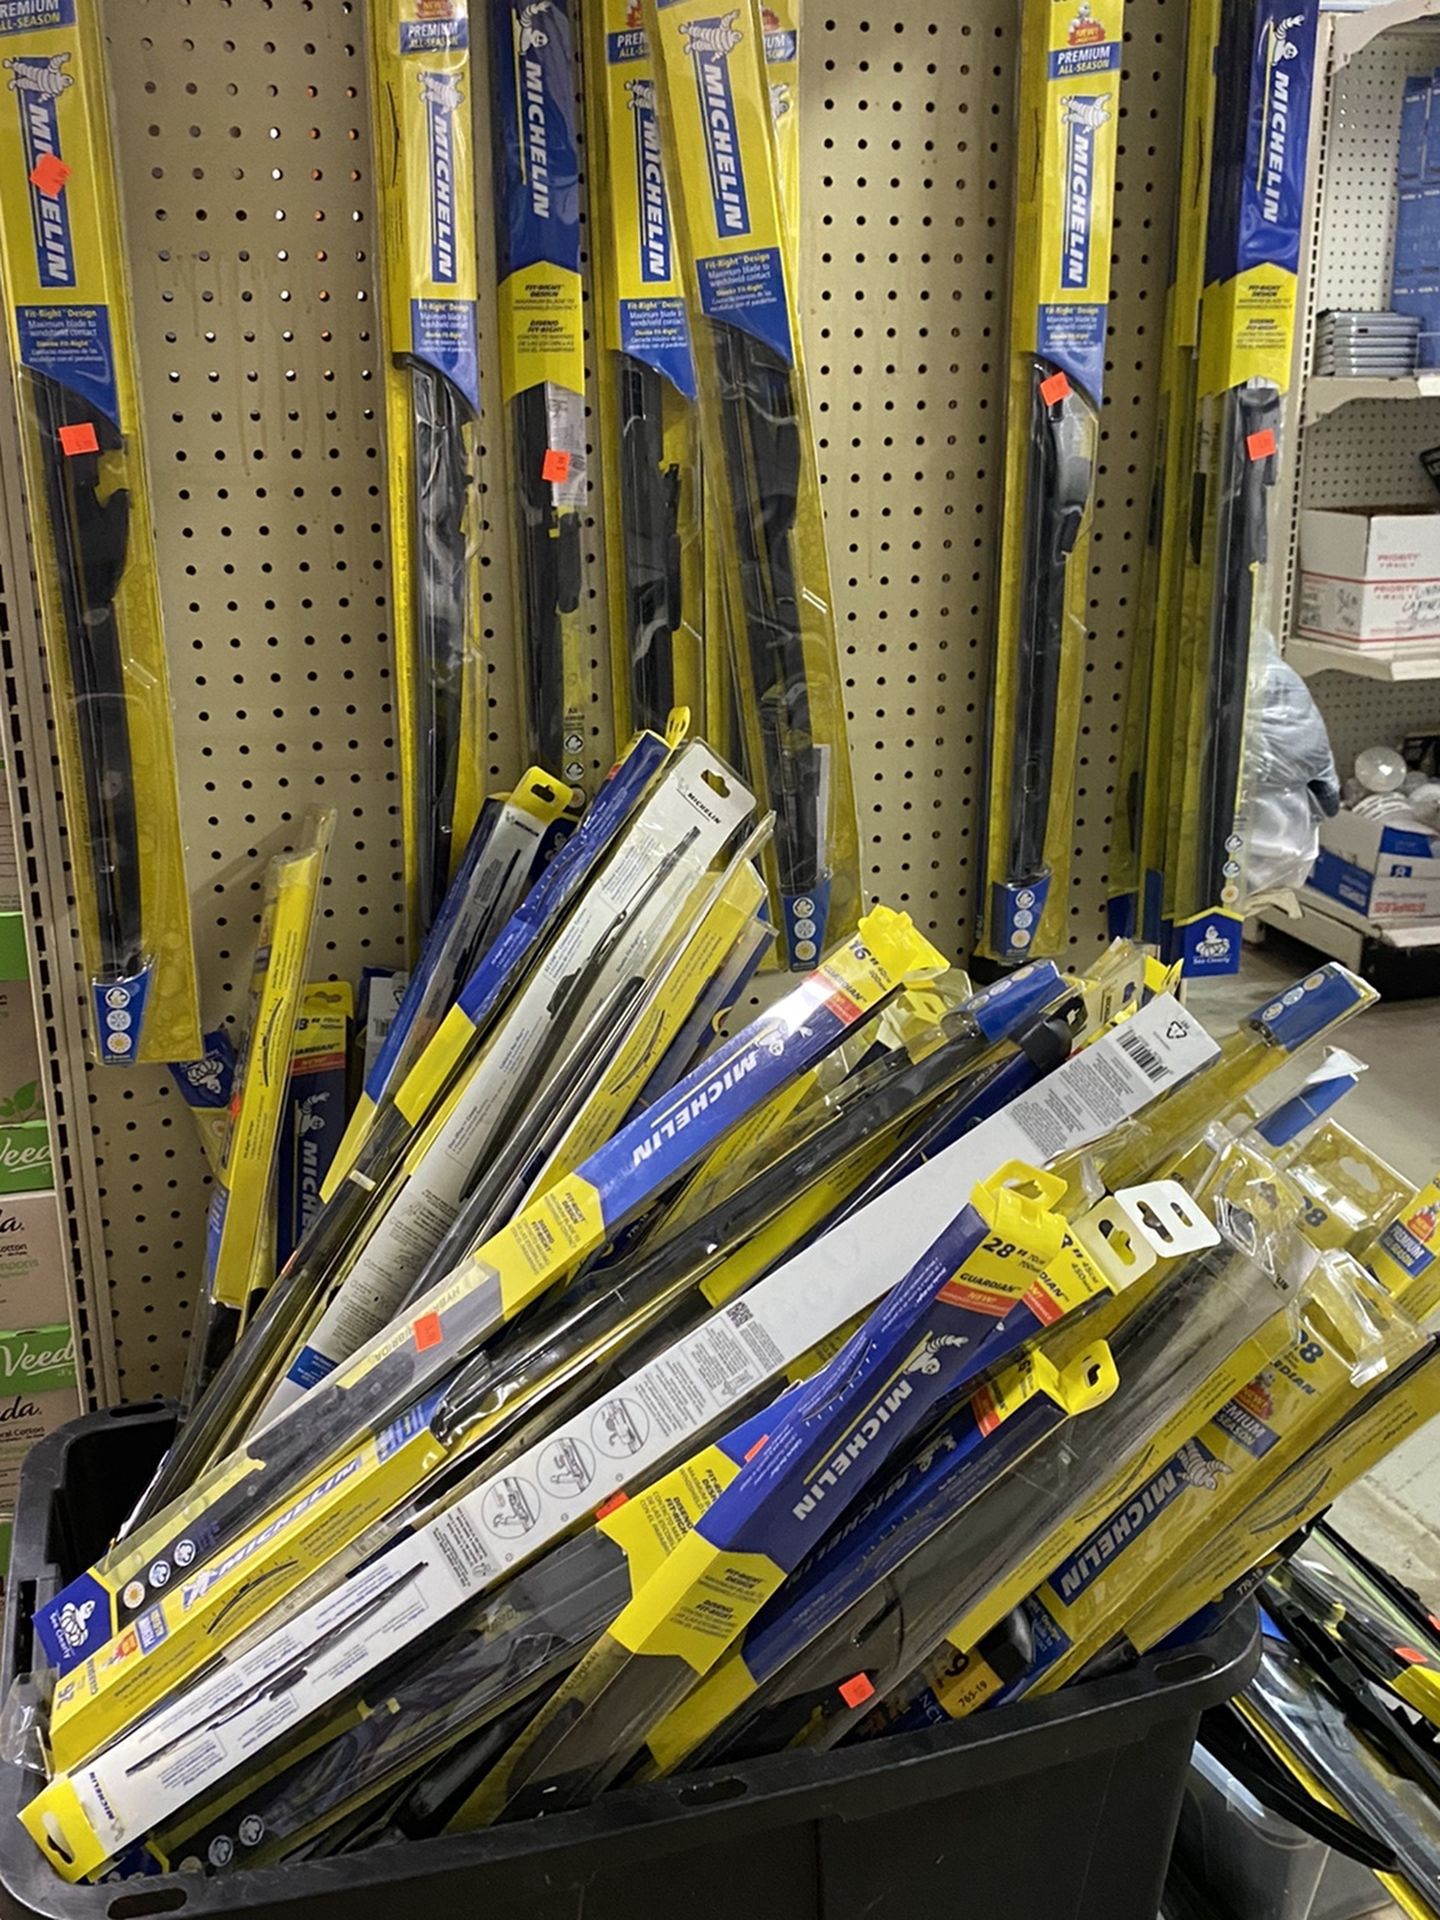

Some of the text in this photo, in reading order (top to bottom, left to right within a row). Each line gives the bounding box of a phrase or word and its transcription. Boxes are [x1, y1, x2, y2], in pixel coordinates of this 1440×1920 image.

[0, 0, 59, 18] REMIUM
[0, 12, 60, 30] LL-SEASON
[617, 32, 647, 48] PREM
[618, 47, 647, 59] ALL-S
[1057, 45, 1111, 65] PREMIUM
[1058, 60, 1110, 76] ALL-SEASON
[525, 60, 550, 219] MICHELIN
[704, 63, 743, 230] MICHELIN
[1264, 71, 1289, 223] MICHELIN
[29, 103, 69, 281] MIELIN
[434, 115, 452, 278] MICHELIN
[643, 119, 665, 277] MICHELIN
[1069, 134, 1089, 283] MICHELIN
[743, 252, 770, 263] Design
[1377, 553, 1418, 561] PRIORITY
[687, 792, 722, 824] MICHELIN
[1206, 955, 1231, 965] Clearly
[631, 1048, 760, 1169] MICHELIN
[959, 1272, 1017, 1294] GUARDIAN
[1039, 1271, 1064, 1298] DIAN
[0, 1335, 75, 1377] Veed
[1273, 1359, 1316, 1395] RDIAN
[14, 1426, 45, 1437] Cotton
[1217, 1412, 1257, 1446] SEASON
[1224, 1401, 1266, 1438] EMIUM
[792, 1380, 913, 1521] MICHELIN
[214, 1456, 360, 1577] MICHELIN
[663, 1497, 689, 1534] FIT-RIGH
[1059, 1468, 1178, 1597] MICHELIN
[55, 1626, 72, 1659] Clearly
[88, 1770, 116, 1821] MICHELIN
